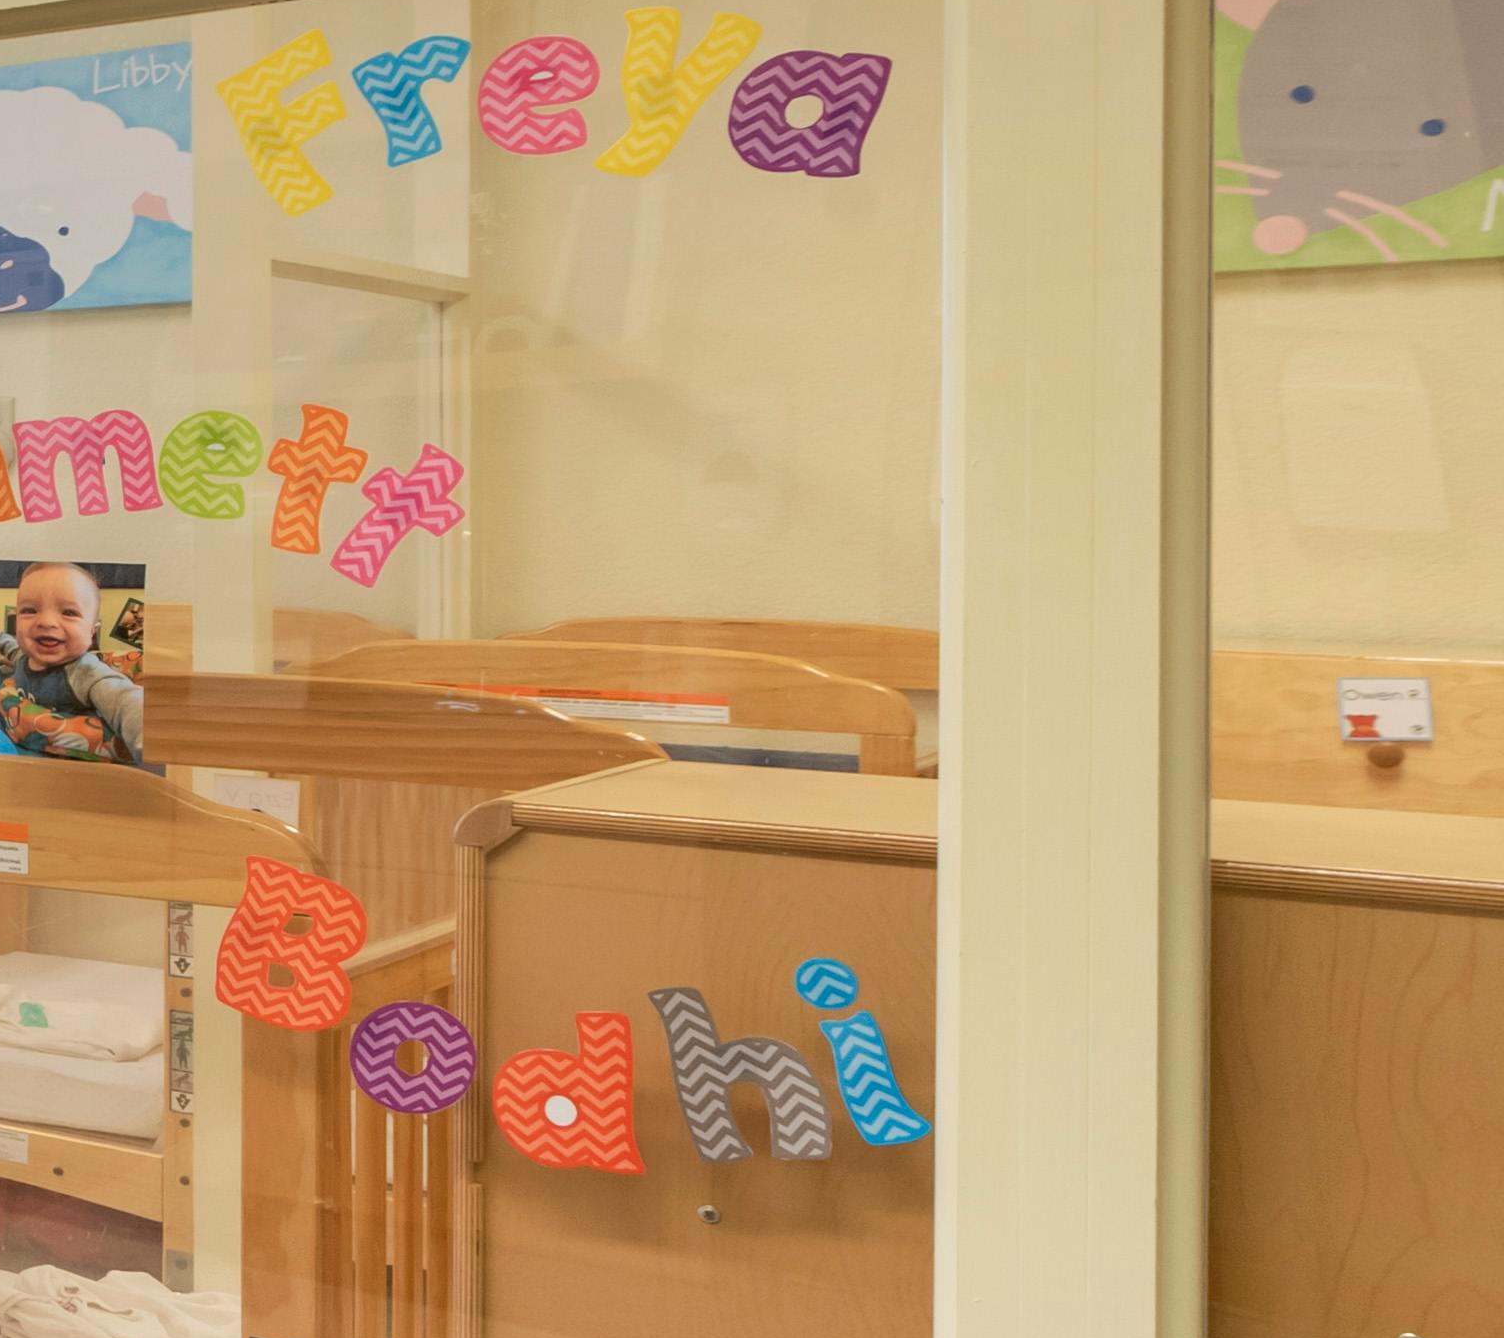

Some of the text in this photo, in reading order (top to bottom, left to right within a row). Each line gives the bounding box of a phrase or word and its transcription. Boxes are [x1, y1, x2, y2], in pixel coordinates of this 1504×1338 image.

[92, 53, 192, 94] Libby
[217, 6, 893, 217] Freya
[214, 855, 931, 1175] Bodhi
